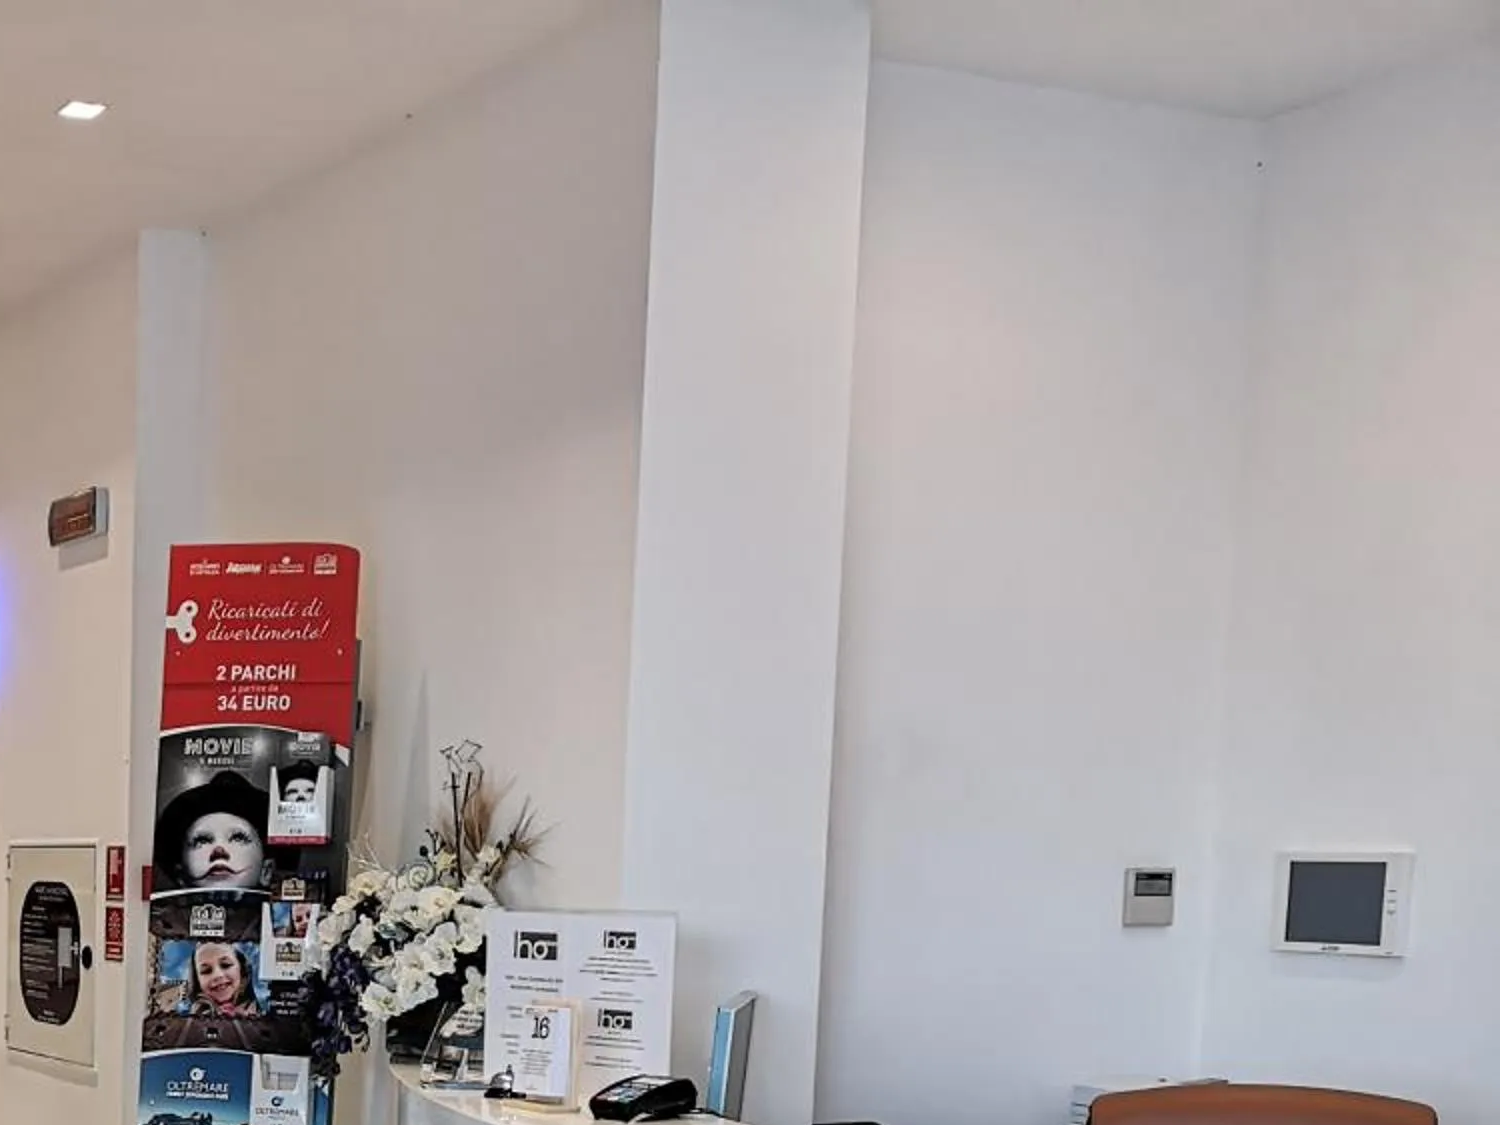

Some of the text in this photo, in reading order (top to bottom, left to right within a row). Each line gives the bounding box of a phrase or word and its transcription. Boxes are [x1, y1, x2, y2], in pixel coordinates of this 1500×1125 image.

[208, 596, 323, 620] Ricaricati di
[205, 619, 331, 641] divertimento!
[215, 664, 297, 682] 2 PARCHI
[217, 695, 291, 711] 34 EURO
[531, 1016, 550, 1039] 16
